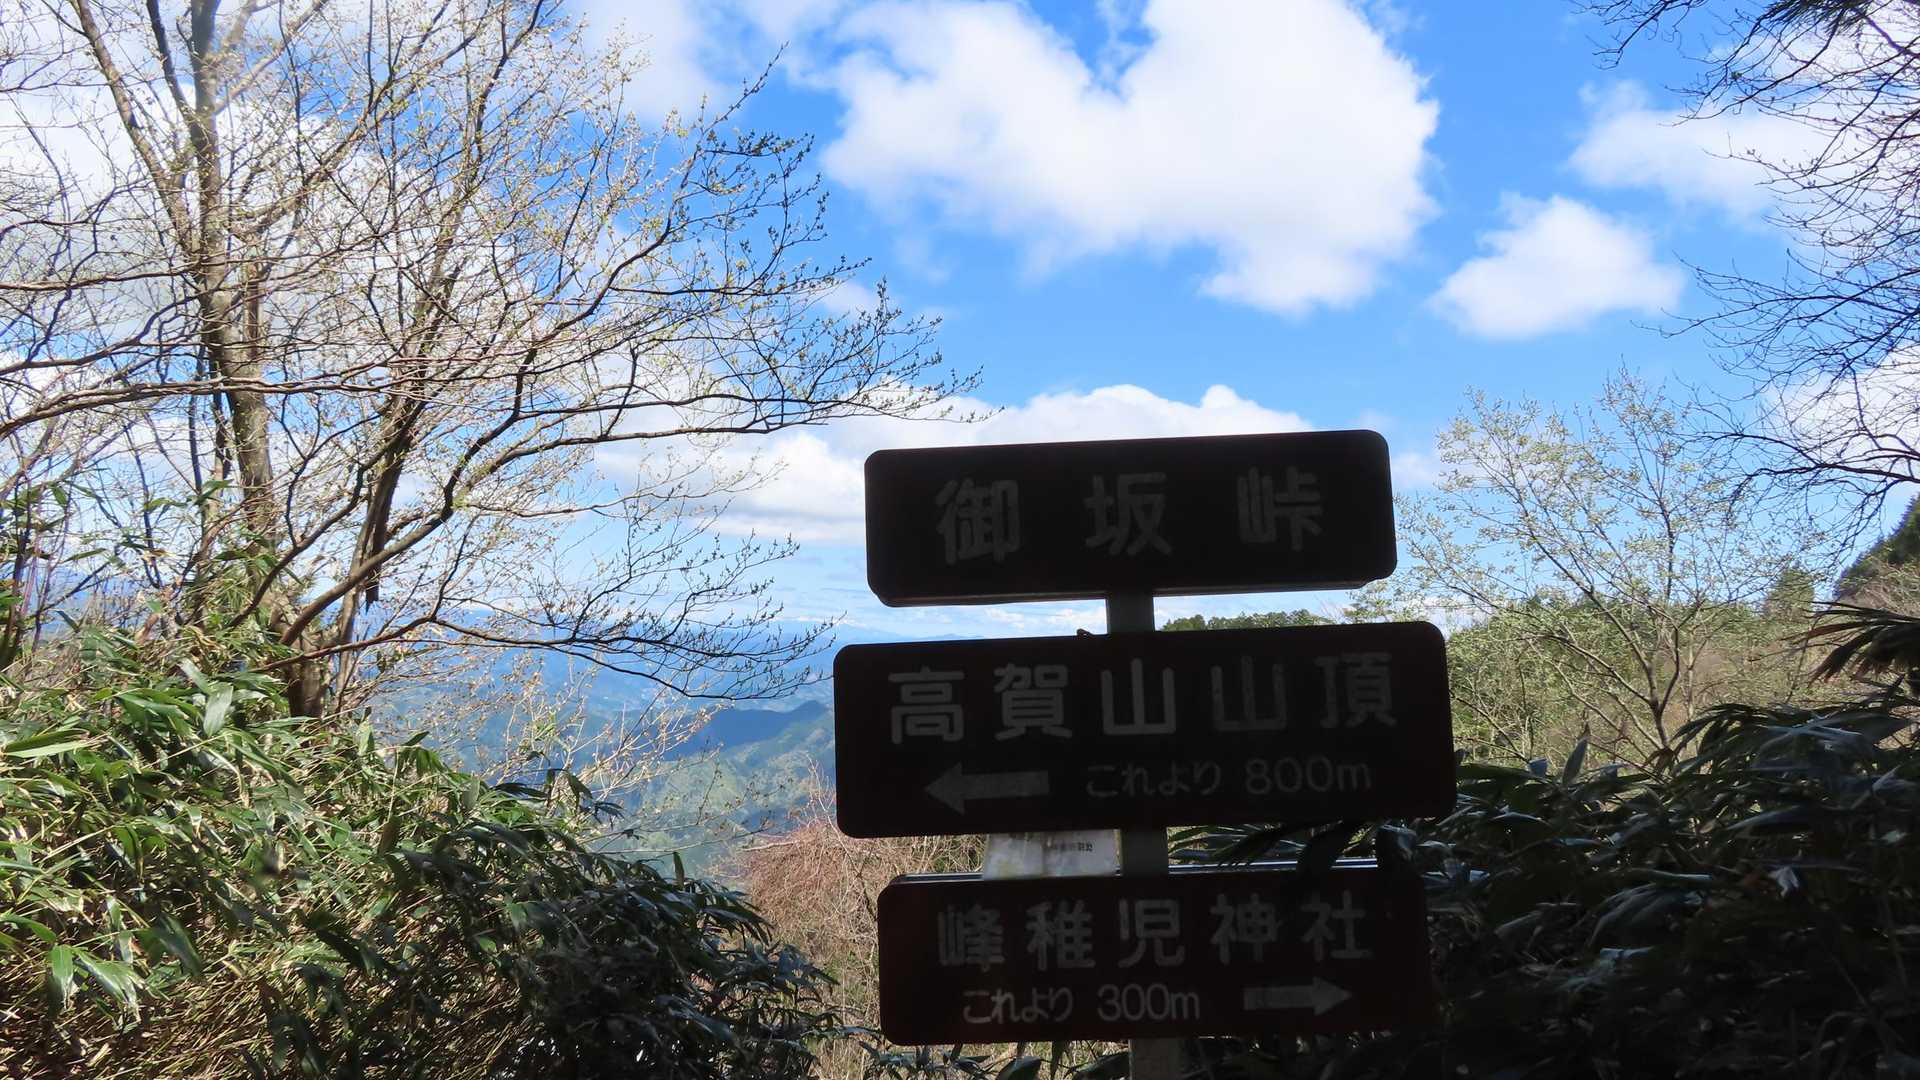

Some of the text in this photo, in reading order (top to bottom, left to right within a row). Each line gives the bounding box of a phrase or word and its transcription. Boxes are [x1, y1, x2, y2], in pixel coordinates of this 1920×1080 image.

[936, 467, 1324, 565] 御坂峠
[888, 652, 1396, 744] 高賀山山頂
[1086, 756, 1372, 800] これより 800m
[938, 890, 1373, 972] 峰稚児神社
[962, 983, 1200, 1025] これより 300m
